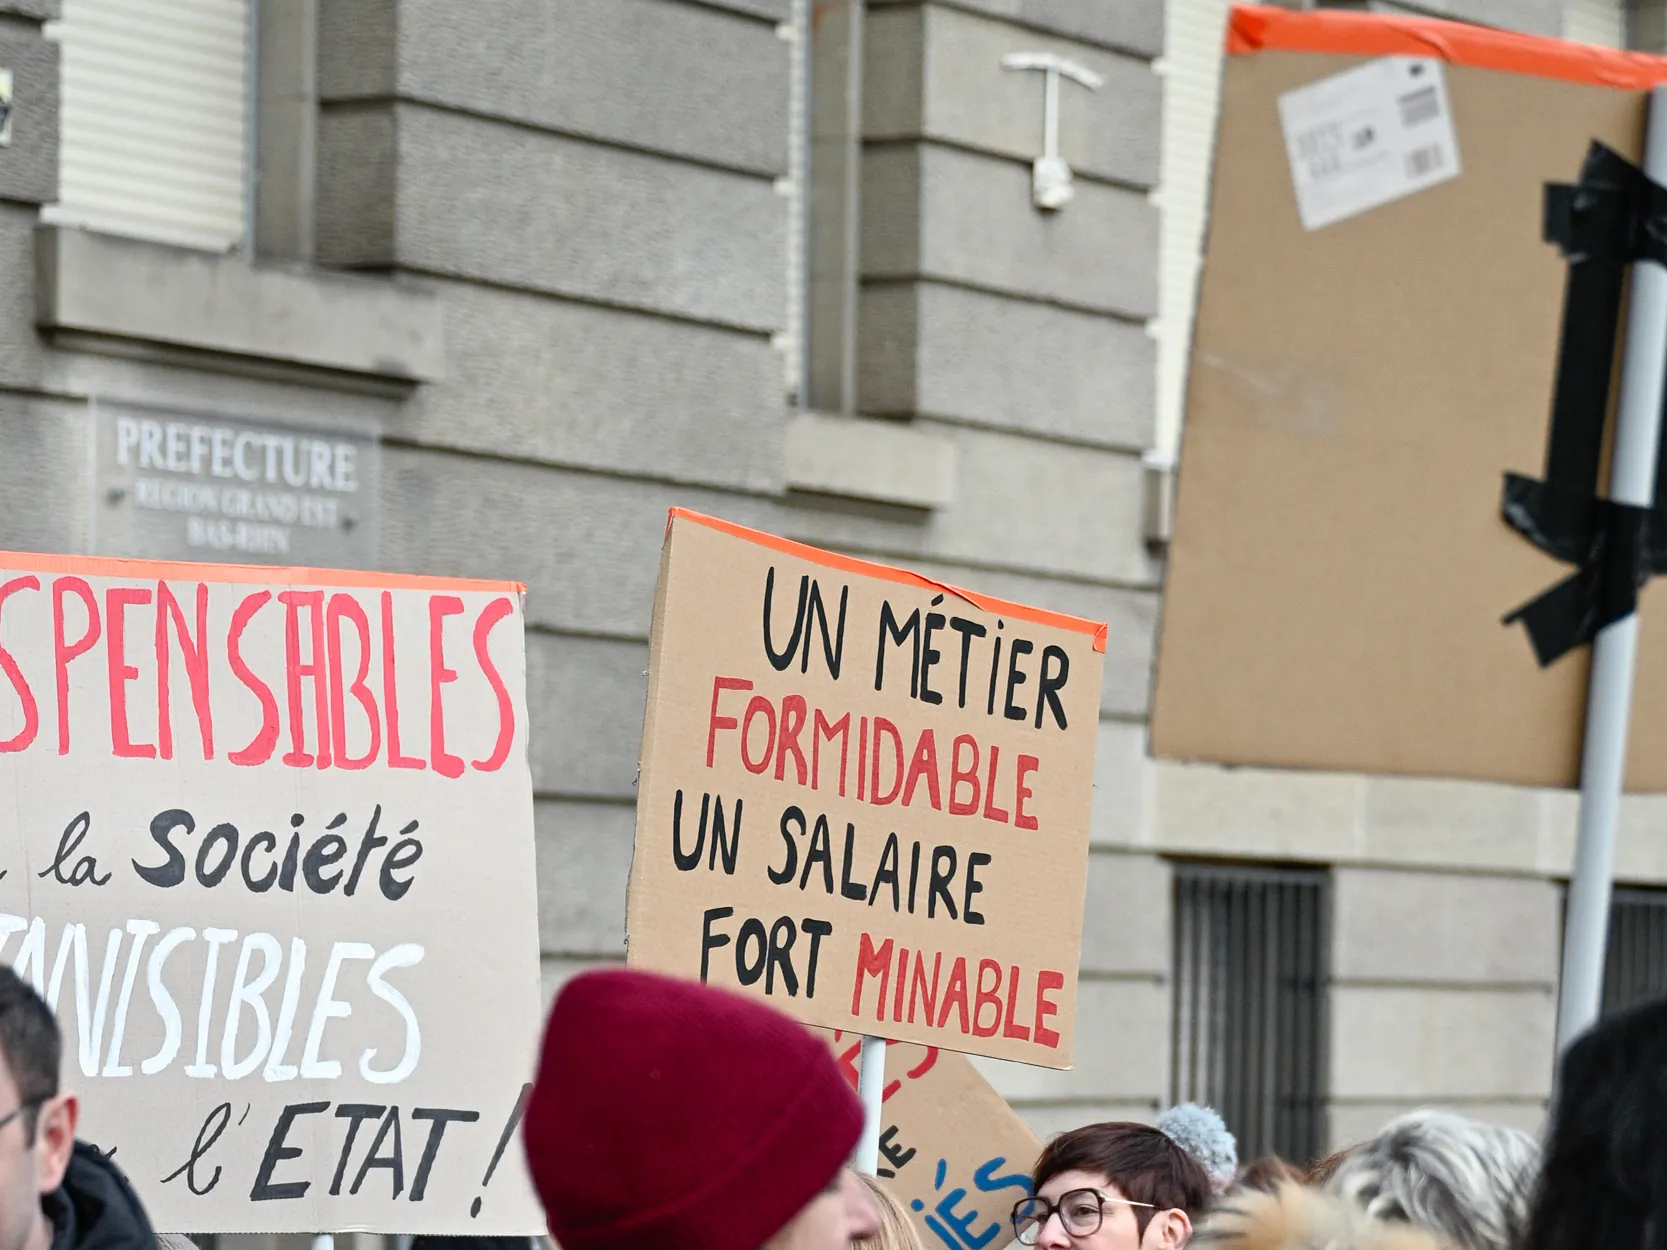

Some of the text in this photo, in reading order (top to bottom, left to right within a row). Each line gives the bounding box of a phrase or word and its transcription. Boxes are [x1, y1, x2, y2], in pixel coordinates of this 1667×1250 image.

[116, 416, 359, 492] PREFECTURE
[764, 567, 848, 680] UN
[706, 676, 1038, 830] FORMIDABLE
[38, 804, 422, 901] la Société
[673, 790, 991, 925] UN SALAIRE
[0, 913, 424, 1083] NVISIBLES
[701, 907, 1064, 1050] FORT MINABLE
